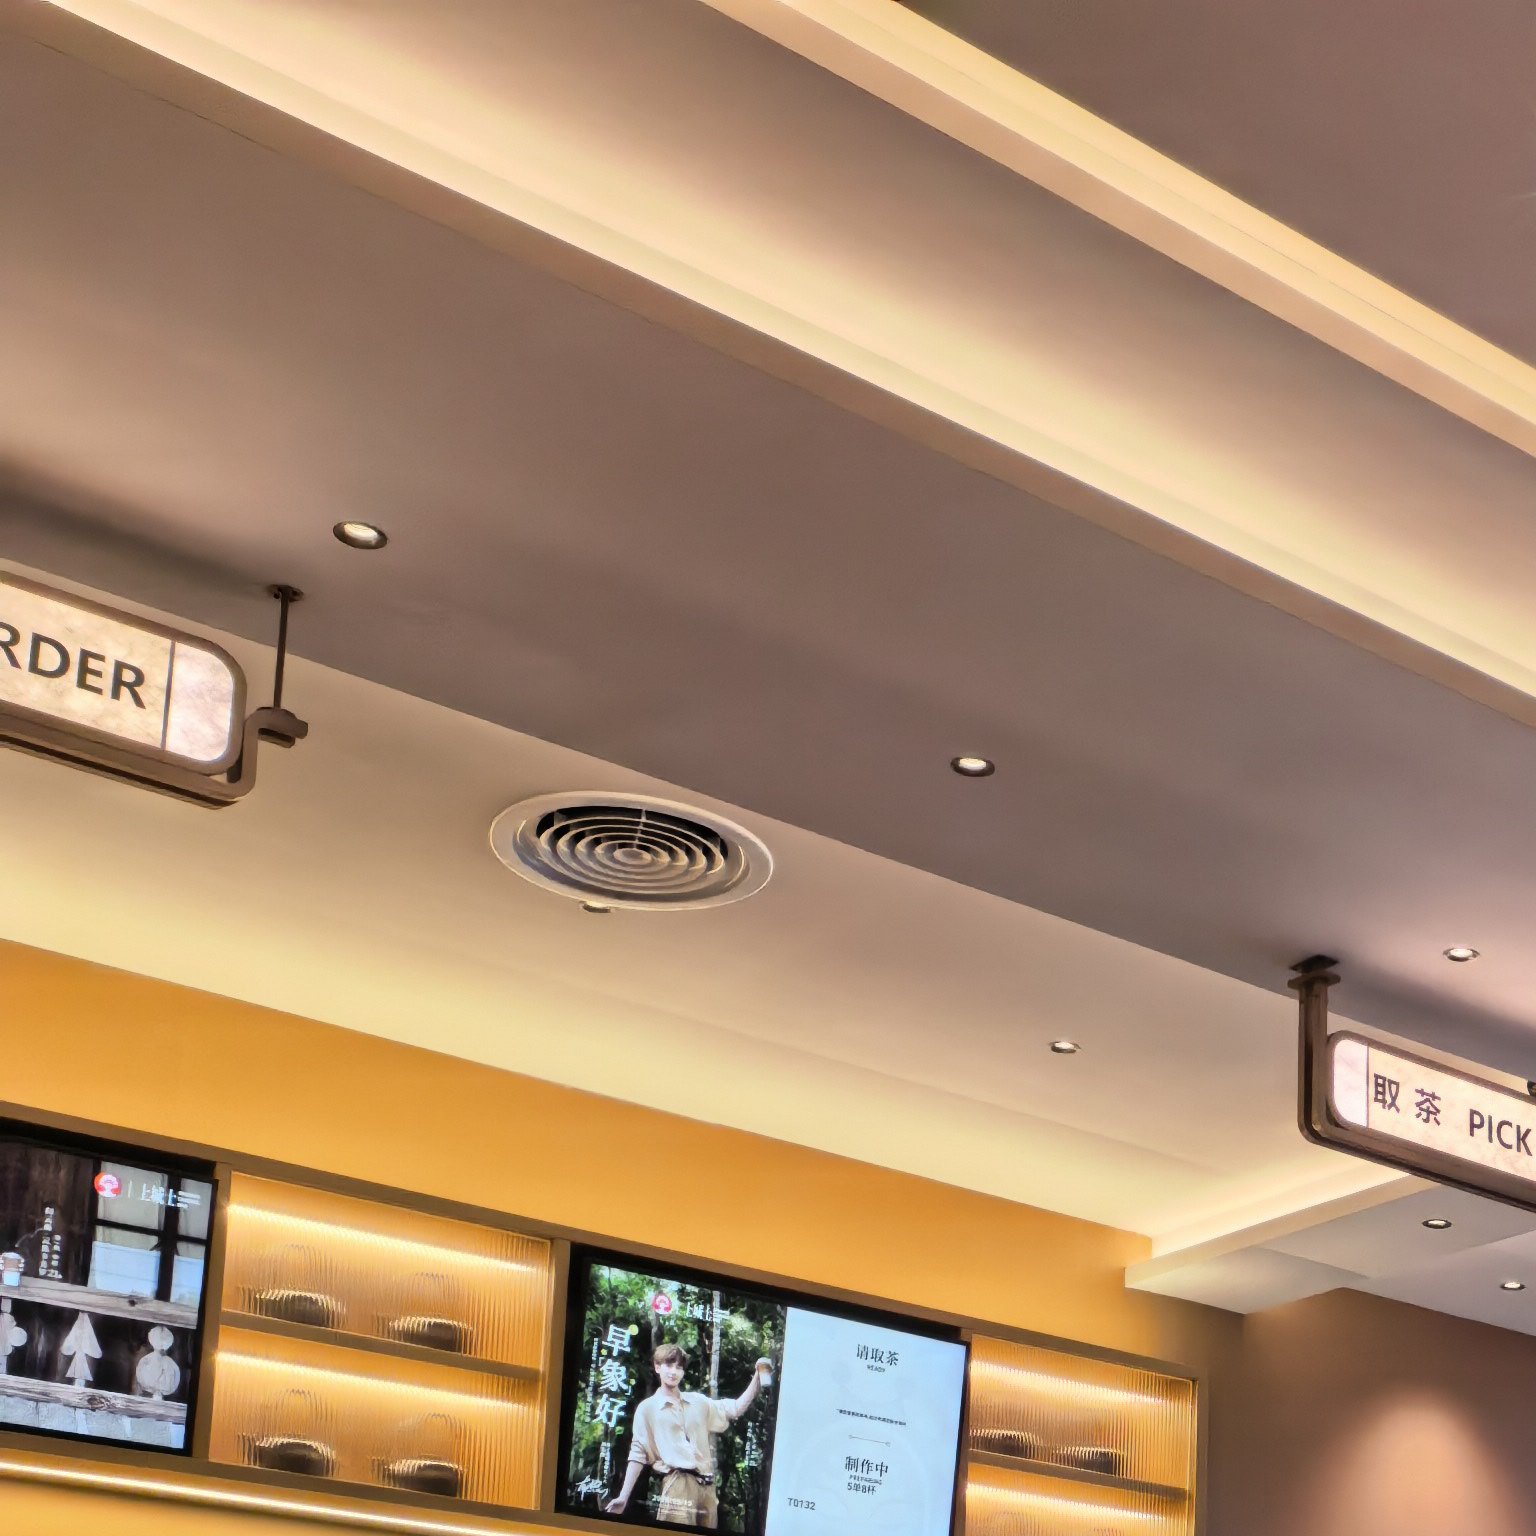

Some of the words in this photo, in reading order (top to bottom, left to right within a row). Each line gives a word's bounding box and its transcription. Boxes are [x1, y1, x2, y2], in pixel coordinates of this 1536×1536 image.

[1469, 1109, 1533, 1157] PICK
[844, 1455, 889, 1478] 制作中
[787, 1496, 816, 1511] T0132
